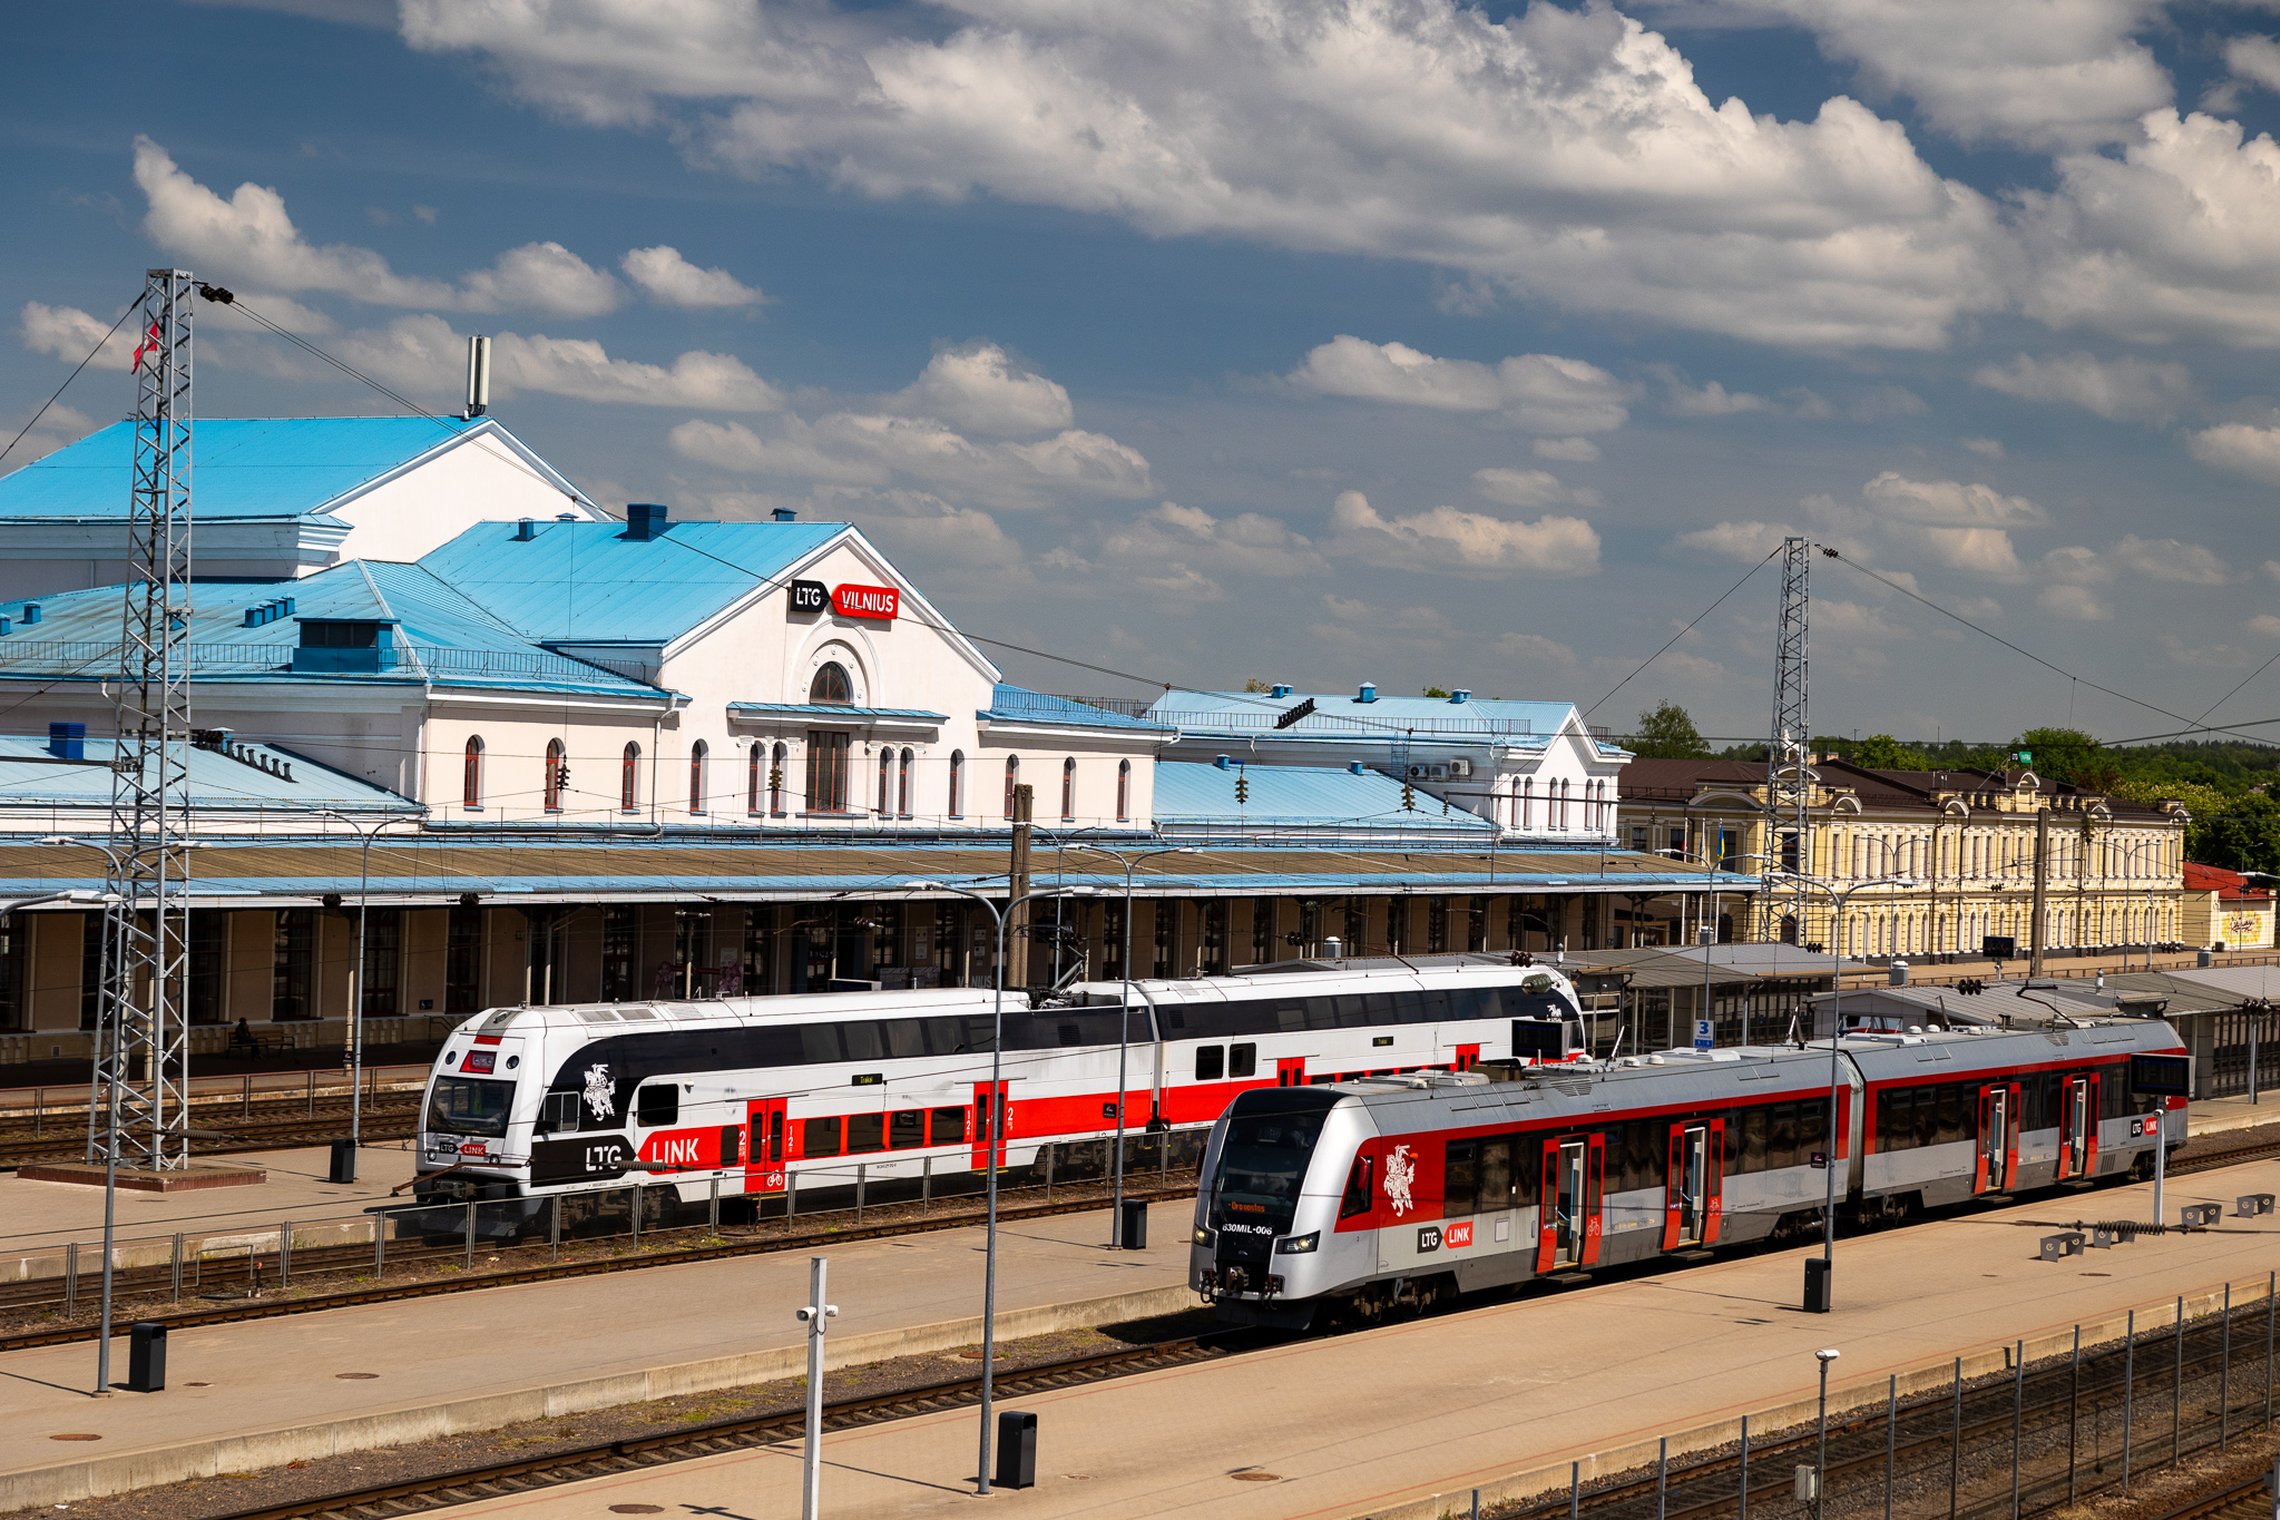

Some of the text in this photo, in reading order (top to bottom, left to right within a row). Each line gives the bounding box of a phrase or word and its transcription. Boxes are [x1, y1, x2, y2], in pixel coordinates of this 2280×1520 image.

[796, 587, 895, 613] LTG VILNIUS
[1699, 1021, 1709, 1035] 3
[1007, 1107, 1014, 1121] 2
[739, 1130, 746, 1146] 2
[440, 1143, 485, 1155] LTG LINK
[585, 1137, 700, 1172] LTG LINK
[1421, 1227, 1471, 1248] LTG LINK
